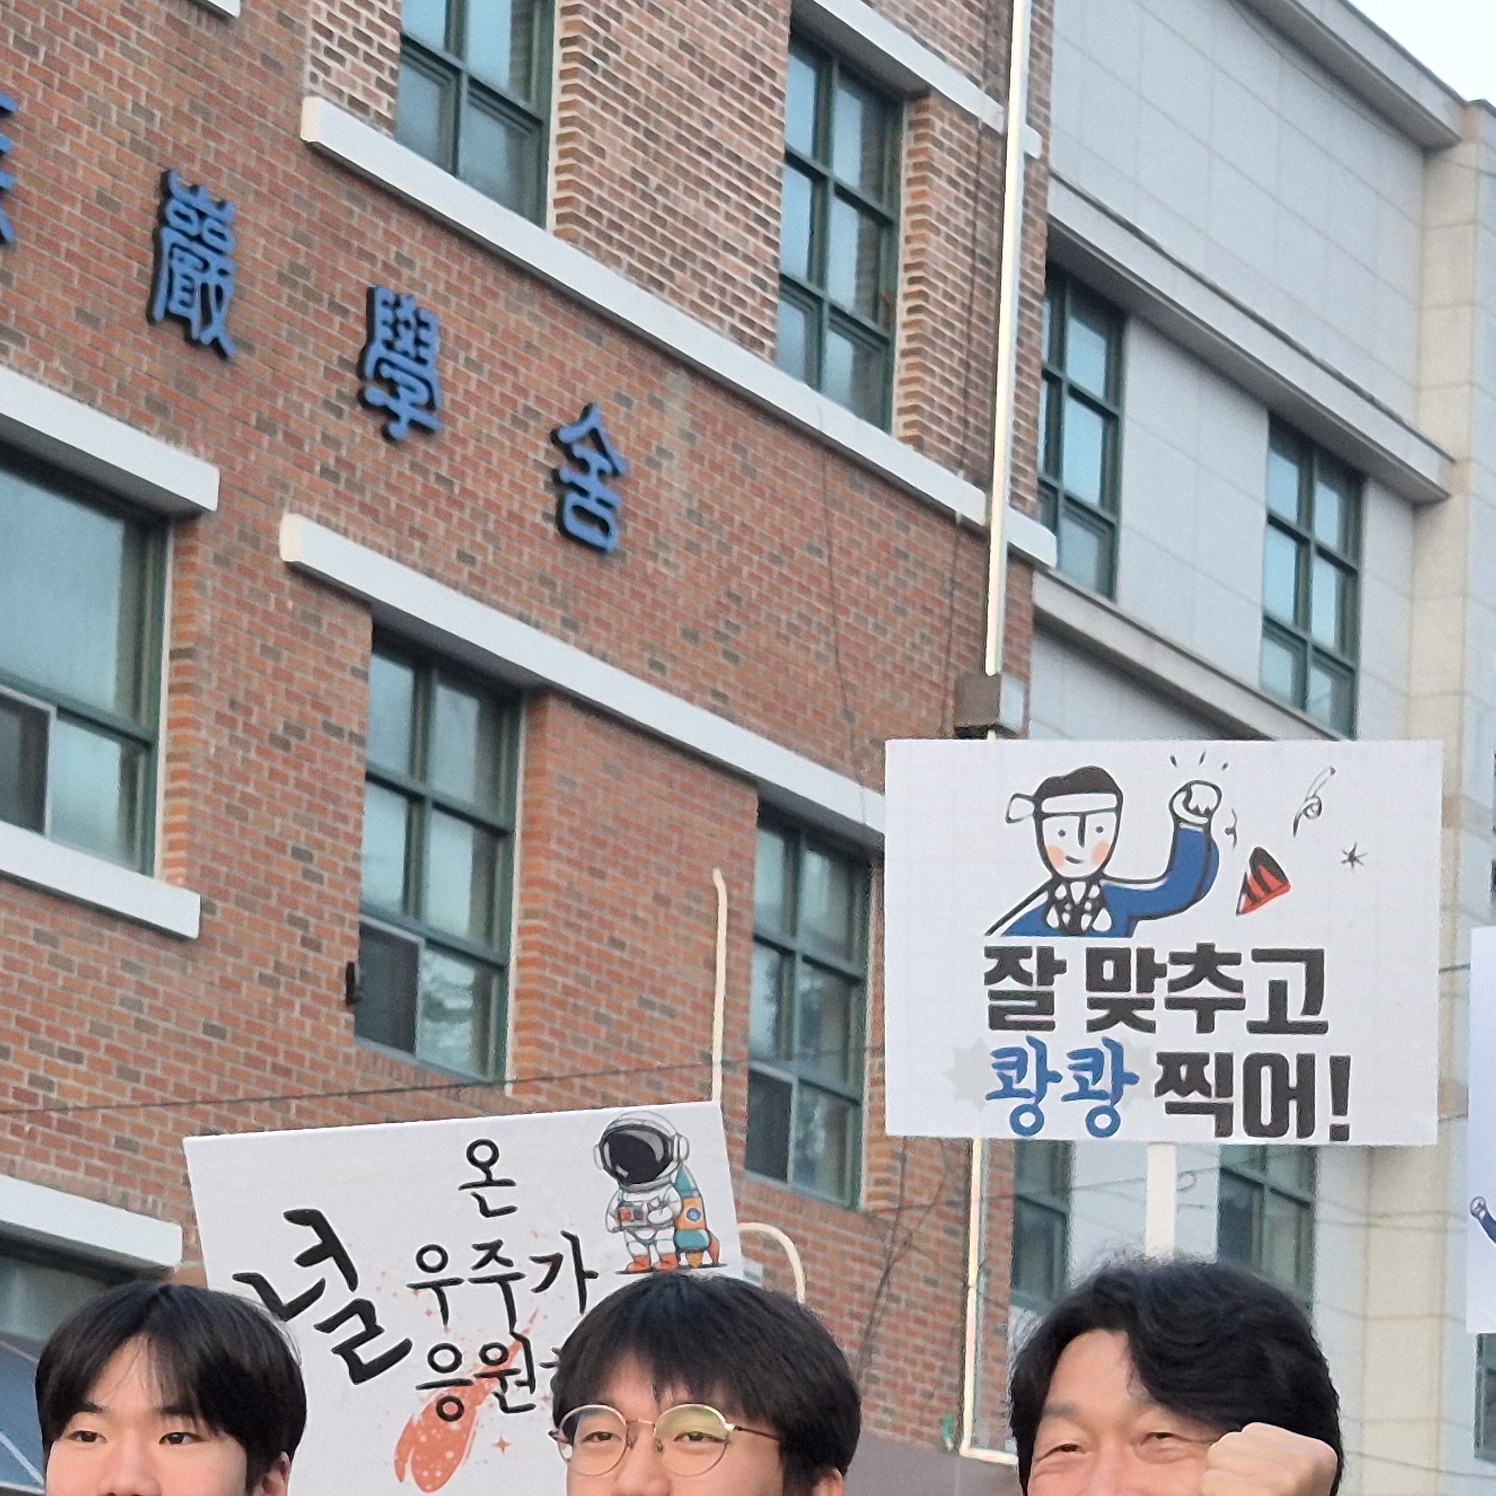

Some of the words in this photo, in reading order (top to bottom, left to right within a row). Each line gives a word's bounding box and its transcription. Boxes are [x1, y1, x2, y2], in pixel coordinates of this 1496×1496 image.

[983, 944, 1067, 1033] 잘
[1084, 942, 1330, 1036] 맞추고
[984, 1035, 1140, 1138] 쾅쾅
[1153, 1051, 1352, 1142] 찍어!
[457, 1138, 519, 1219] 온
[232, 1208, 413, 1386] 널
[406, 1230, 599, 1334] 우주가
[415, 1332, 561, 1422] 응원
